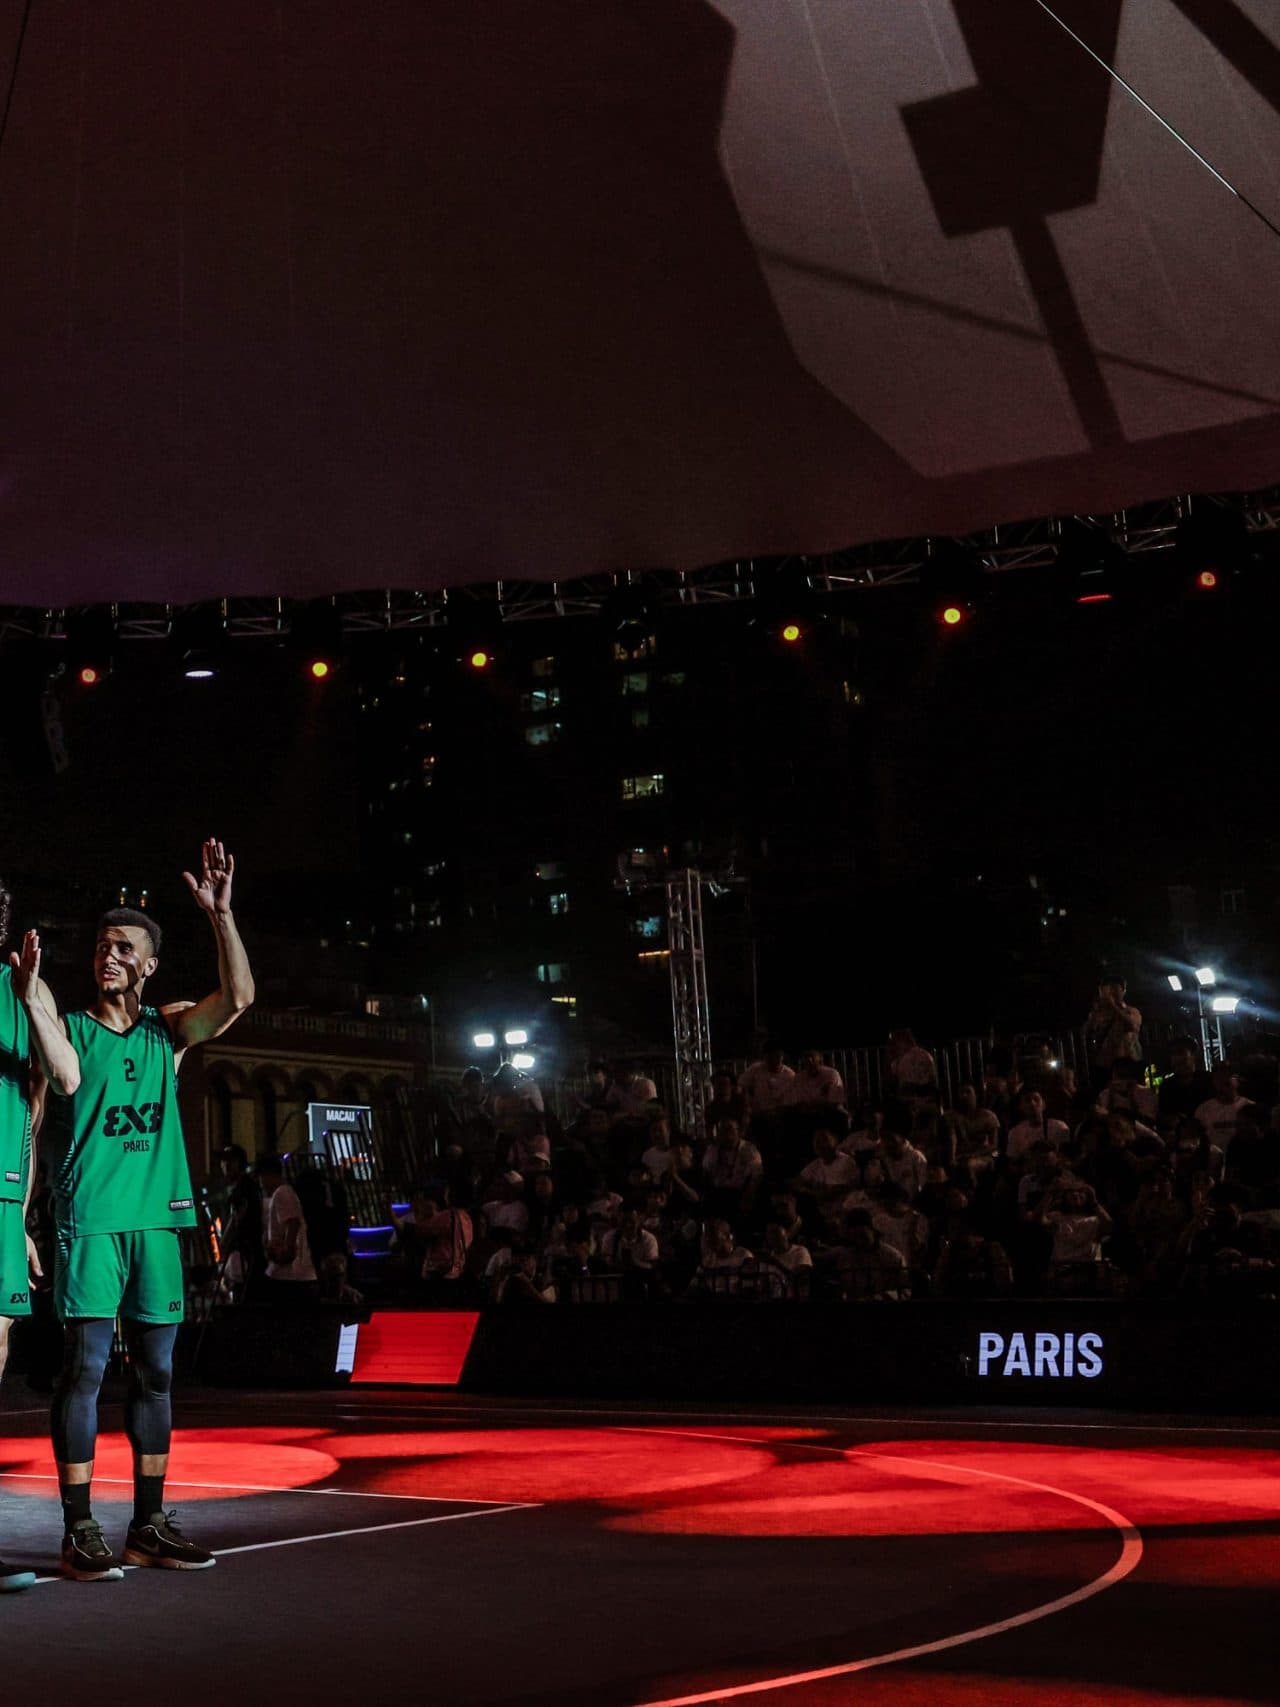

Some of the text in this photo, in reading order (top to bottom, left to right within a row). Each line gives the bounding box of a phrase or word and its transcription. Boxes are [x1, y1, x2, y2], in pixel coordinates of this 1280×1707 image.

[123, 1058, 136, 1082] 2
[326, 1109, 355, 1122] MACAU
[123, 1140, 150, 1153] PARIS
[977, 1331, 1104, 1378] PARIS
